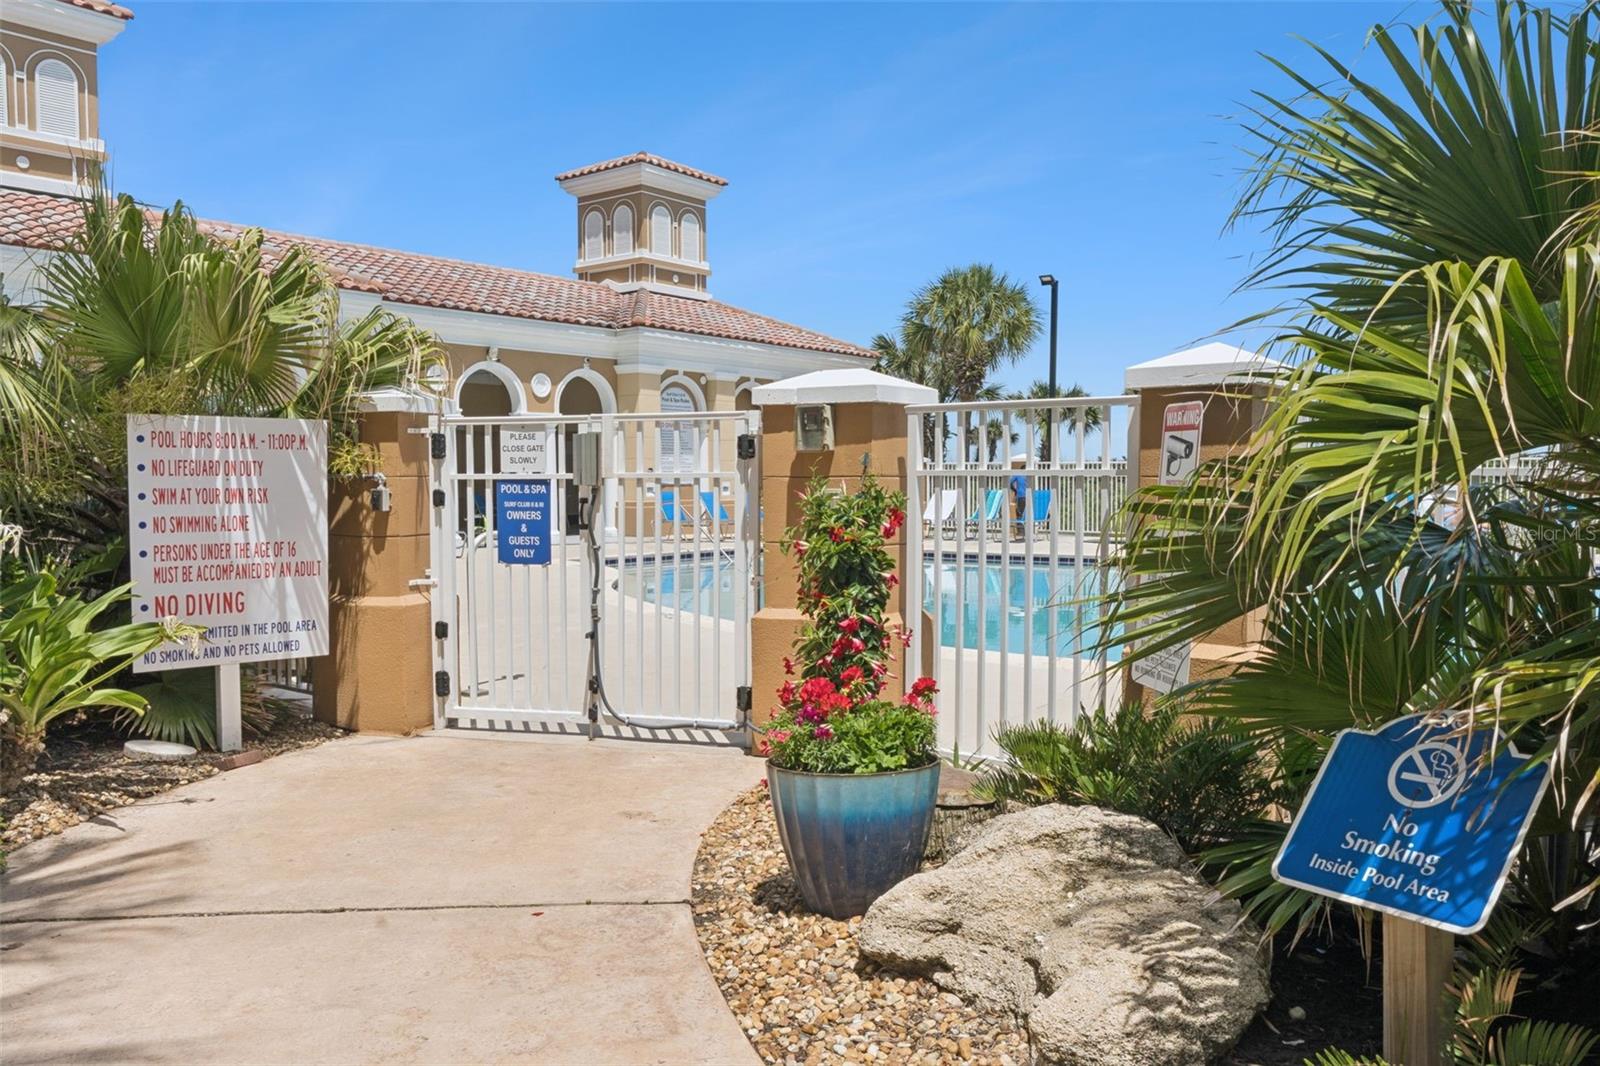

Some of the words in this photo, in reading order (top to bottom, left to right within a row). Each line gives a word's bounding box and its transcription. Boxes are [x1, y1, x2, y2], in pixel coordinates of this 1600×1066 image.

[1166, 409, 1200, 427] WARNING
[151, 430, 176, 448] POOL
[180, 431, 212, 449] HOURS
[215, 432, 237, 450] 8:00
[240, 433, 258, 450] A.M.
[152, 460, 164, 476] NO
[168, 460, 220, 476] LIFEGUARD
[224, 460, 236, 476] ON
[240, 460, 264, 476] DUTY
[152, 488, 176, 504] SWIM
[180, 488, 191, 504] AT
[195, 488, 220, 504] YOUR
[224, 488, 244, 504] OWN
[248, 488, 268, 504] RISK
[500, 484, 523, 494] POOL
[524, 484, 530, 494] &
[531, 484, 546, 494] SPA
[152, 516, 166, 534] NO
[170, 516, 217, 534] SWIMMING
[220, 515, 250, 532] ALONE
[506, 510, 542, 520] OWNERS
[520, 524, 528, 532] &
[508, 536, 540, 546] GUESTS
[154, 542, 198, 562] PERSONS
[200, 542, 231, 560] UNDER
[234, 542, 250, 559] THE
[254, 542, 270, 558] AGE
[274, 542, 284, 558] OF
[287, 542, 297, 558] 16
[514, 548, 535, 558] ONLY
[154, 566, 178, 584] MUST
[182, 565, 194, 582] BE
[196, 562, 262, 582] ACCOMPANIED
[264, 562, 276, 579] BY
[279, 561, 292, 578] AN
[294, 560, 321, 577] ADULT
[154, 595, 179, 618] NO
[186, 592, 245, 616] DIVING
[192, 625, 238, 640] MITTED
[242, 625, 250, 637] IN
[254, 623, 268, 636] THE
[271, 621, 292, 634] POOL
[296, 620, 316, 632] AREA
[144, 652, 156, 664] NO
[203, 646, 221, 659] AND
[224, 644, 236, 657] NO
[239, 642, 260, 656] PETS
[262, 640, 300, 654] ALLOWED
[1382, 814, 1419, 837] No
[1341, 830, 1441, 876] Smoking
[1309, 854, 1359, 879] Inside
[1362, 866, 1402, 891] Pool
[1404, 879, 1450, 904] Area
